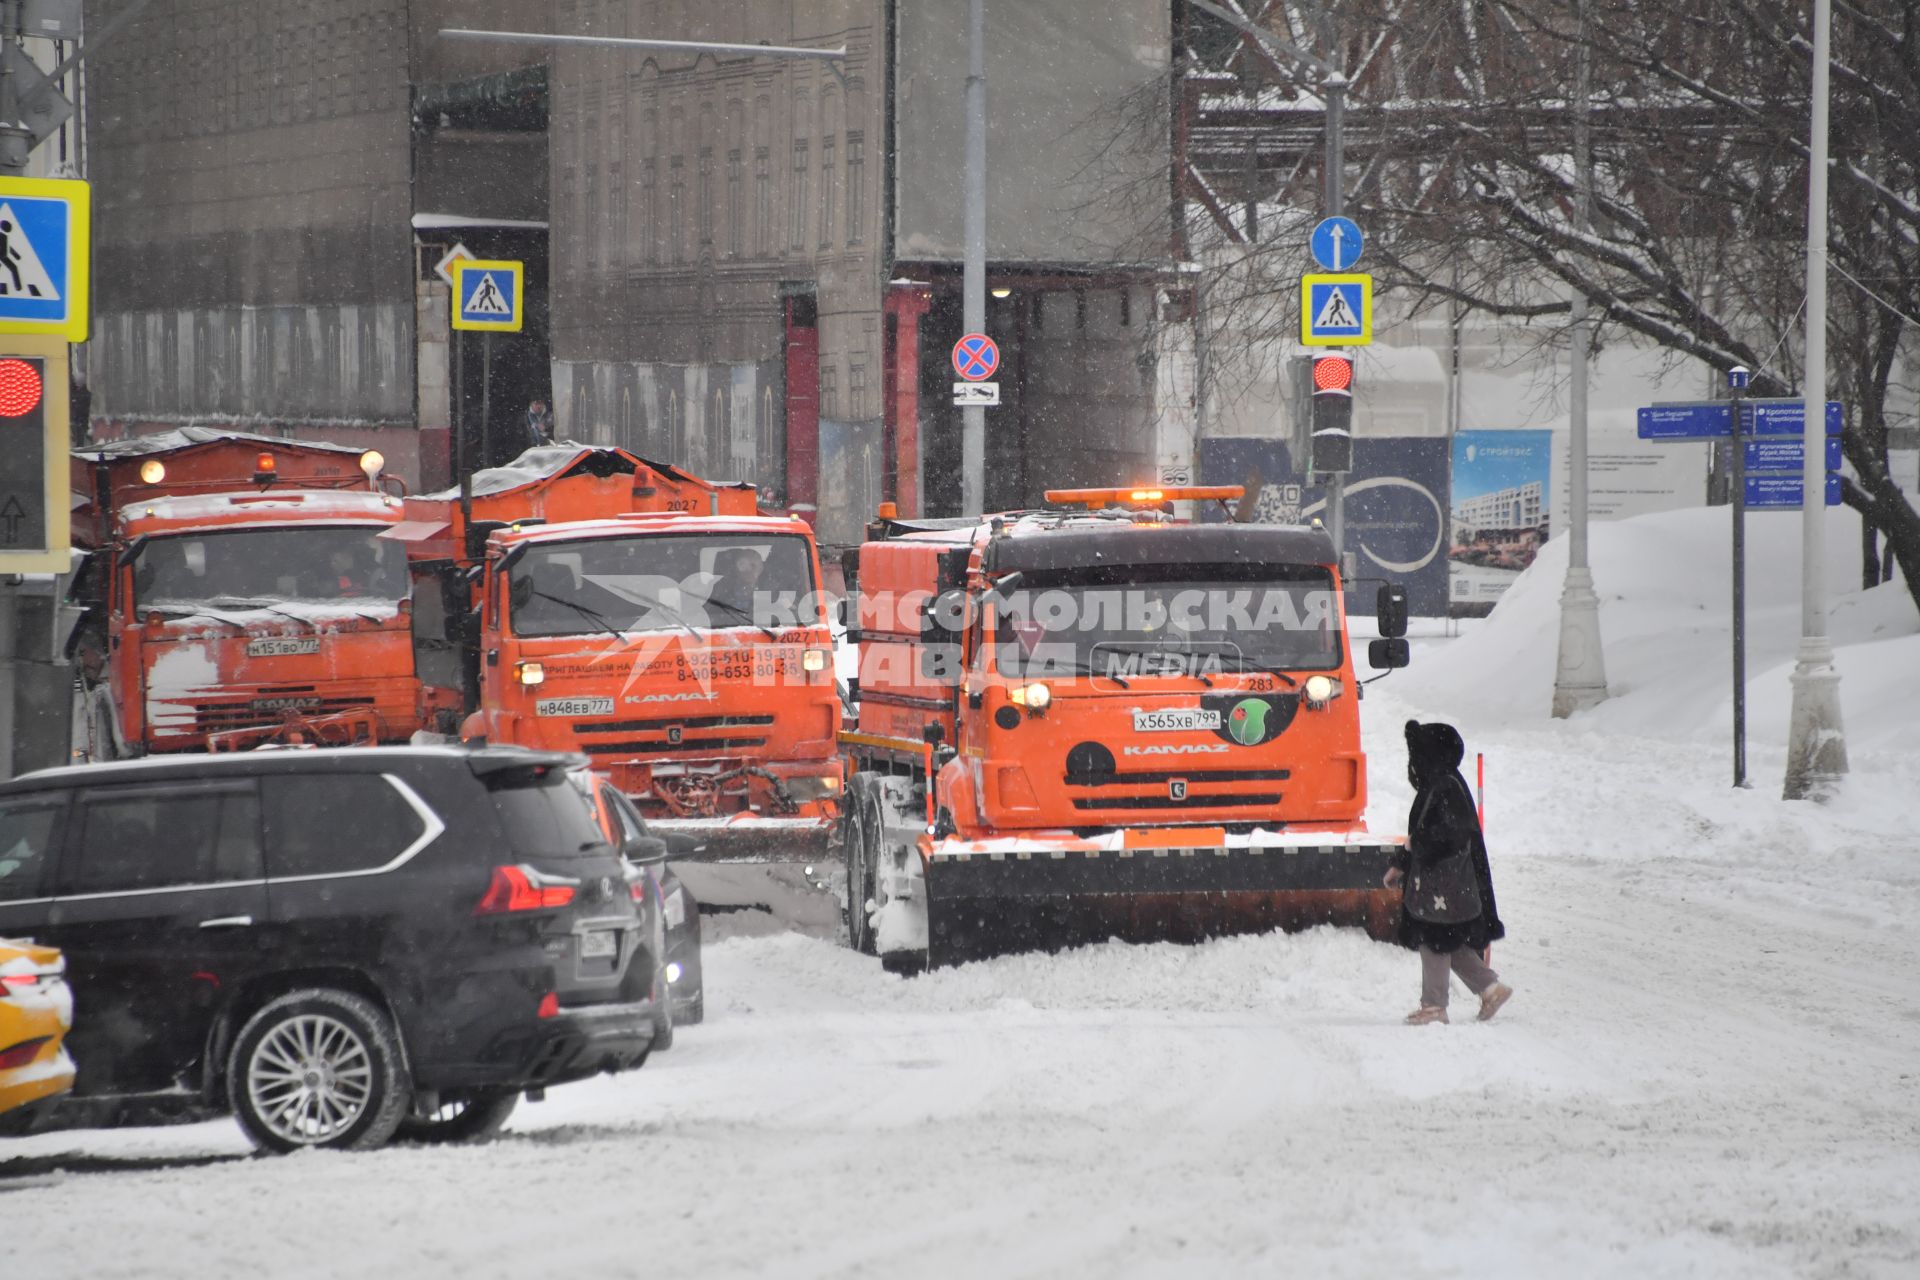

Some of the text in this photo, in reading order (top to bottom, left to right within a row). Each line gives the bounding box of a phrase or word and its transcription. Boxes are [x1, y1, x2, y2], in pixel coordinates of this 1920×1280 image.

[667, 499, 697, 512] 2027
[780, 632, 809, 643] 2027
[544, 661, 673, 674] ПРИГЛАШАЕМ НА РАБОТУ
[1249, 678, 1273, 691] 283
[253, 698, 320, 710] KAMAZ
[625, 691, 718, 704] KAMAZ
[1196, 712, 1217, 723] 799
[1123, 743, 1230, 756] KAMAZ
